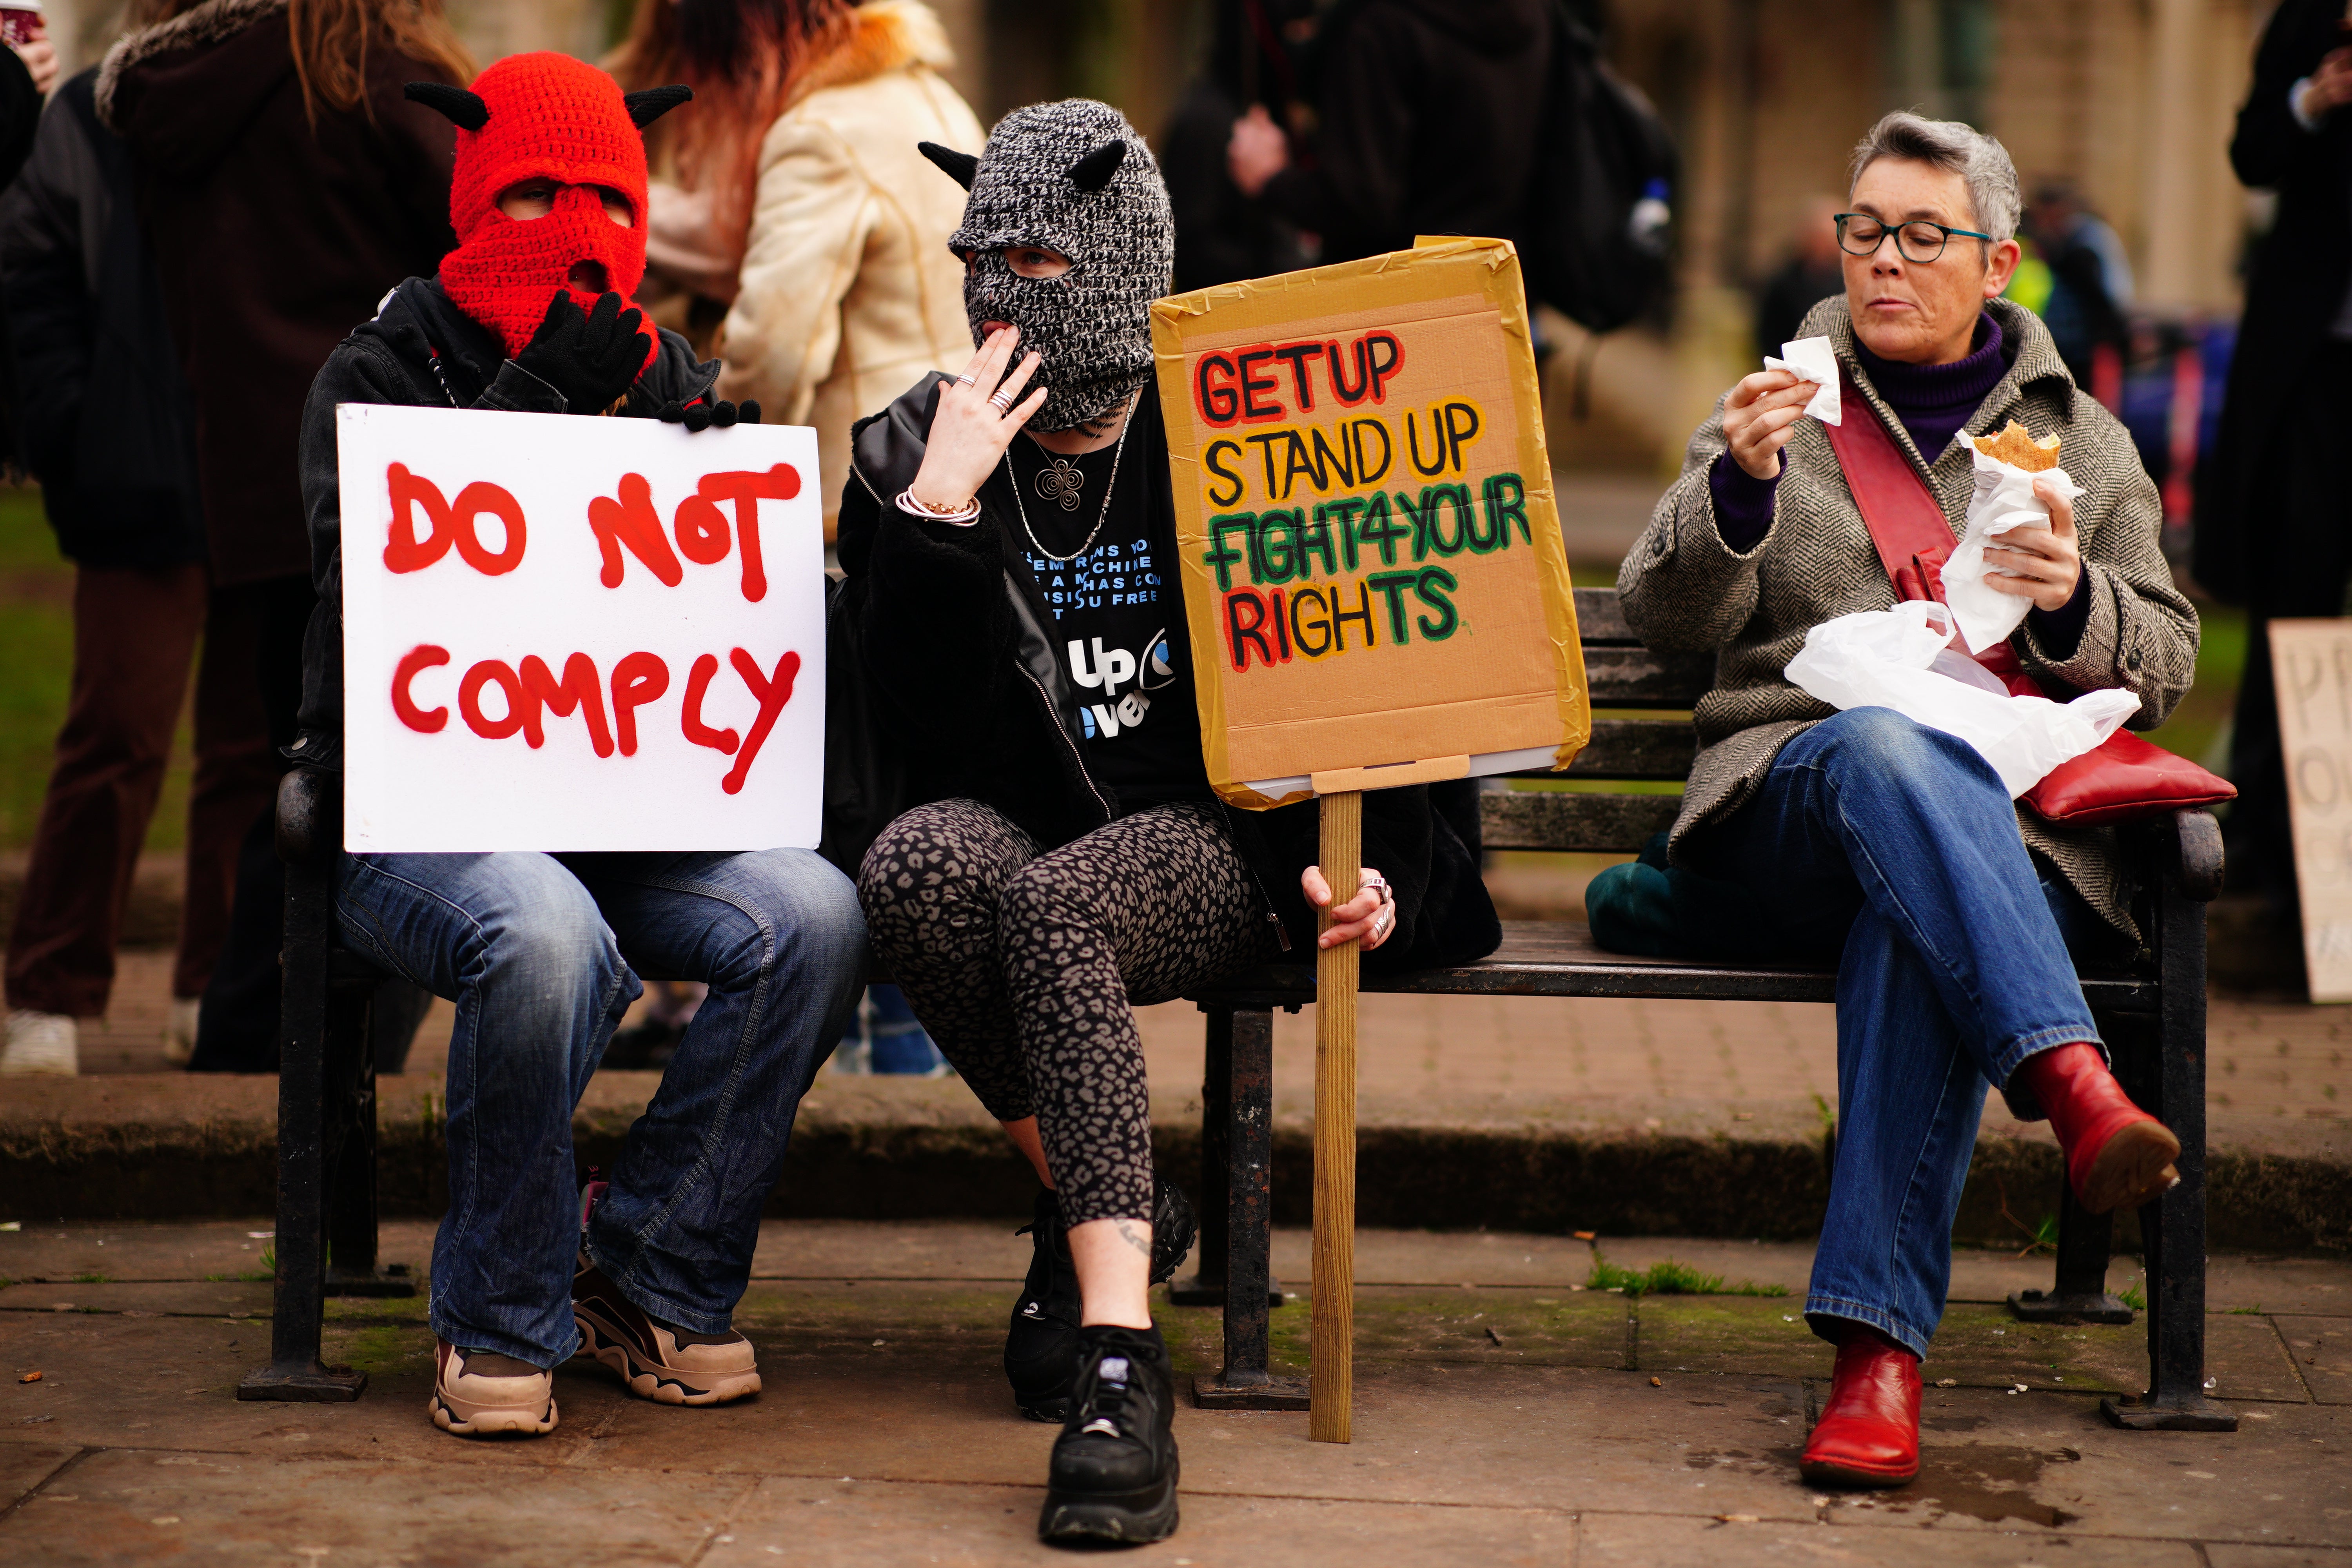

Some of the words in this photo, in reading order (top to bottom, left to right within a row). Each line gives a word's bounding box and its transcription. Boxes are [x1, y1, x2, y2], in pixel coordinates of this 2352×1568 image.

[1202, 414, 1397, 514] STAND
[1403, 395, 1486, 483] UP
[383, 462, 527, 576] DO
[587, 463, 801, 603] NOT
[1083, 577, 1125, 592] HAS
[1112, 590, 1157, 605] FREE
[1222, 564, 1459, 673] RIGHTS
[390, 643, 801, 795] COMPLY
[1067, 637, 1136, 697] Up
